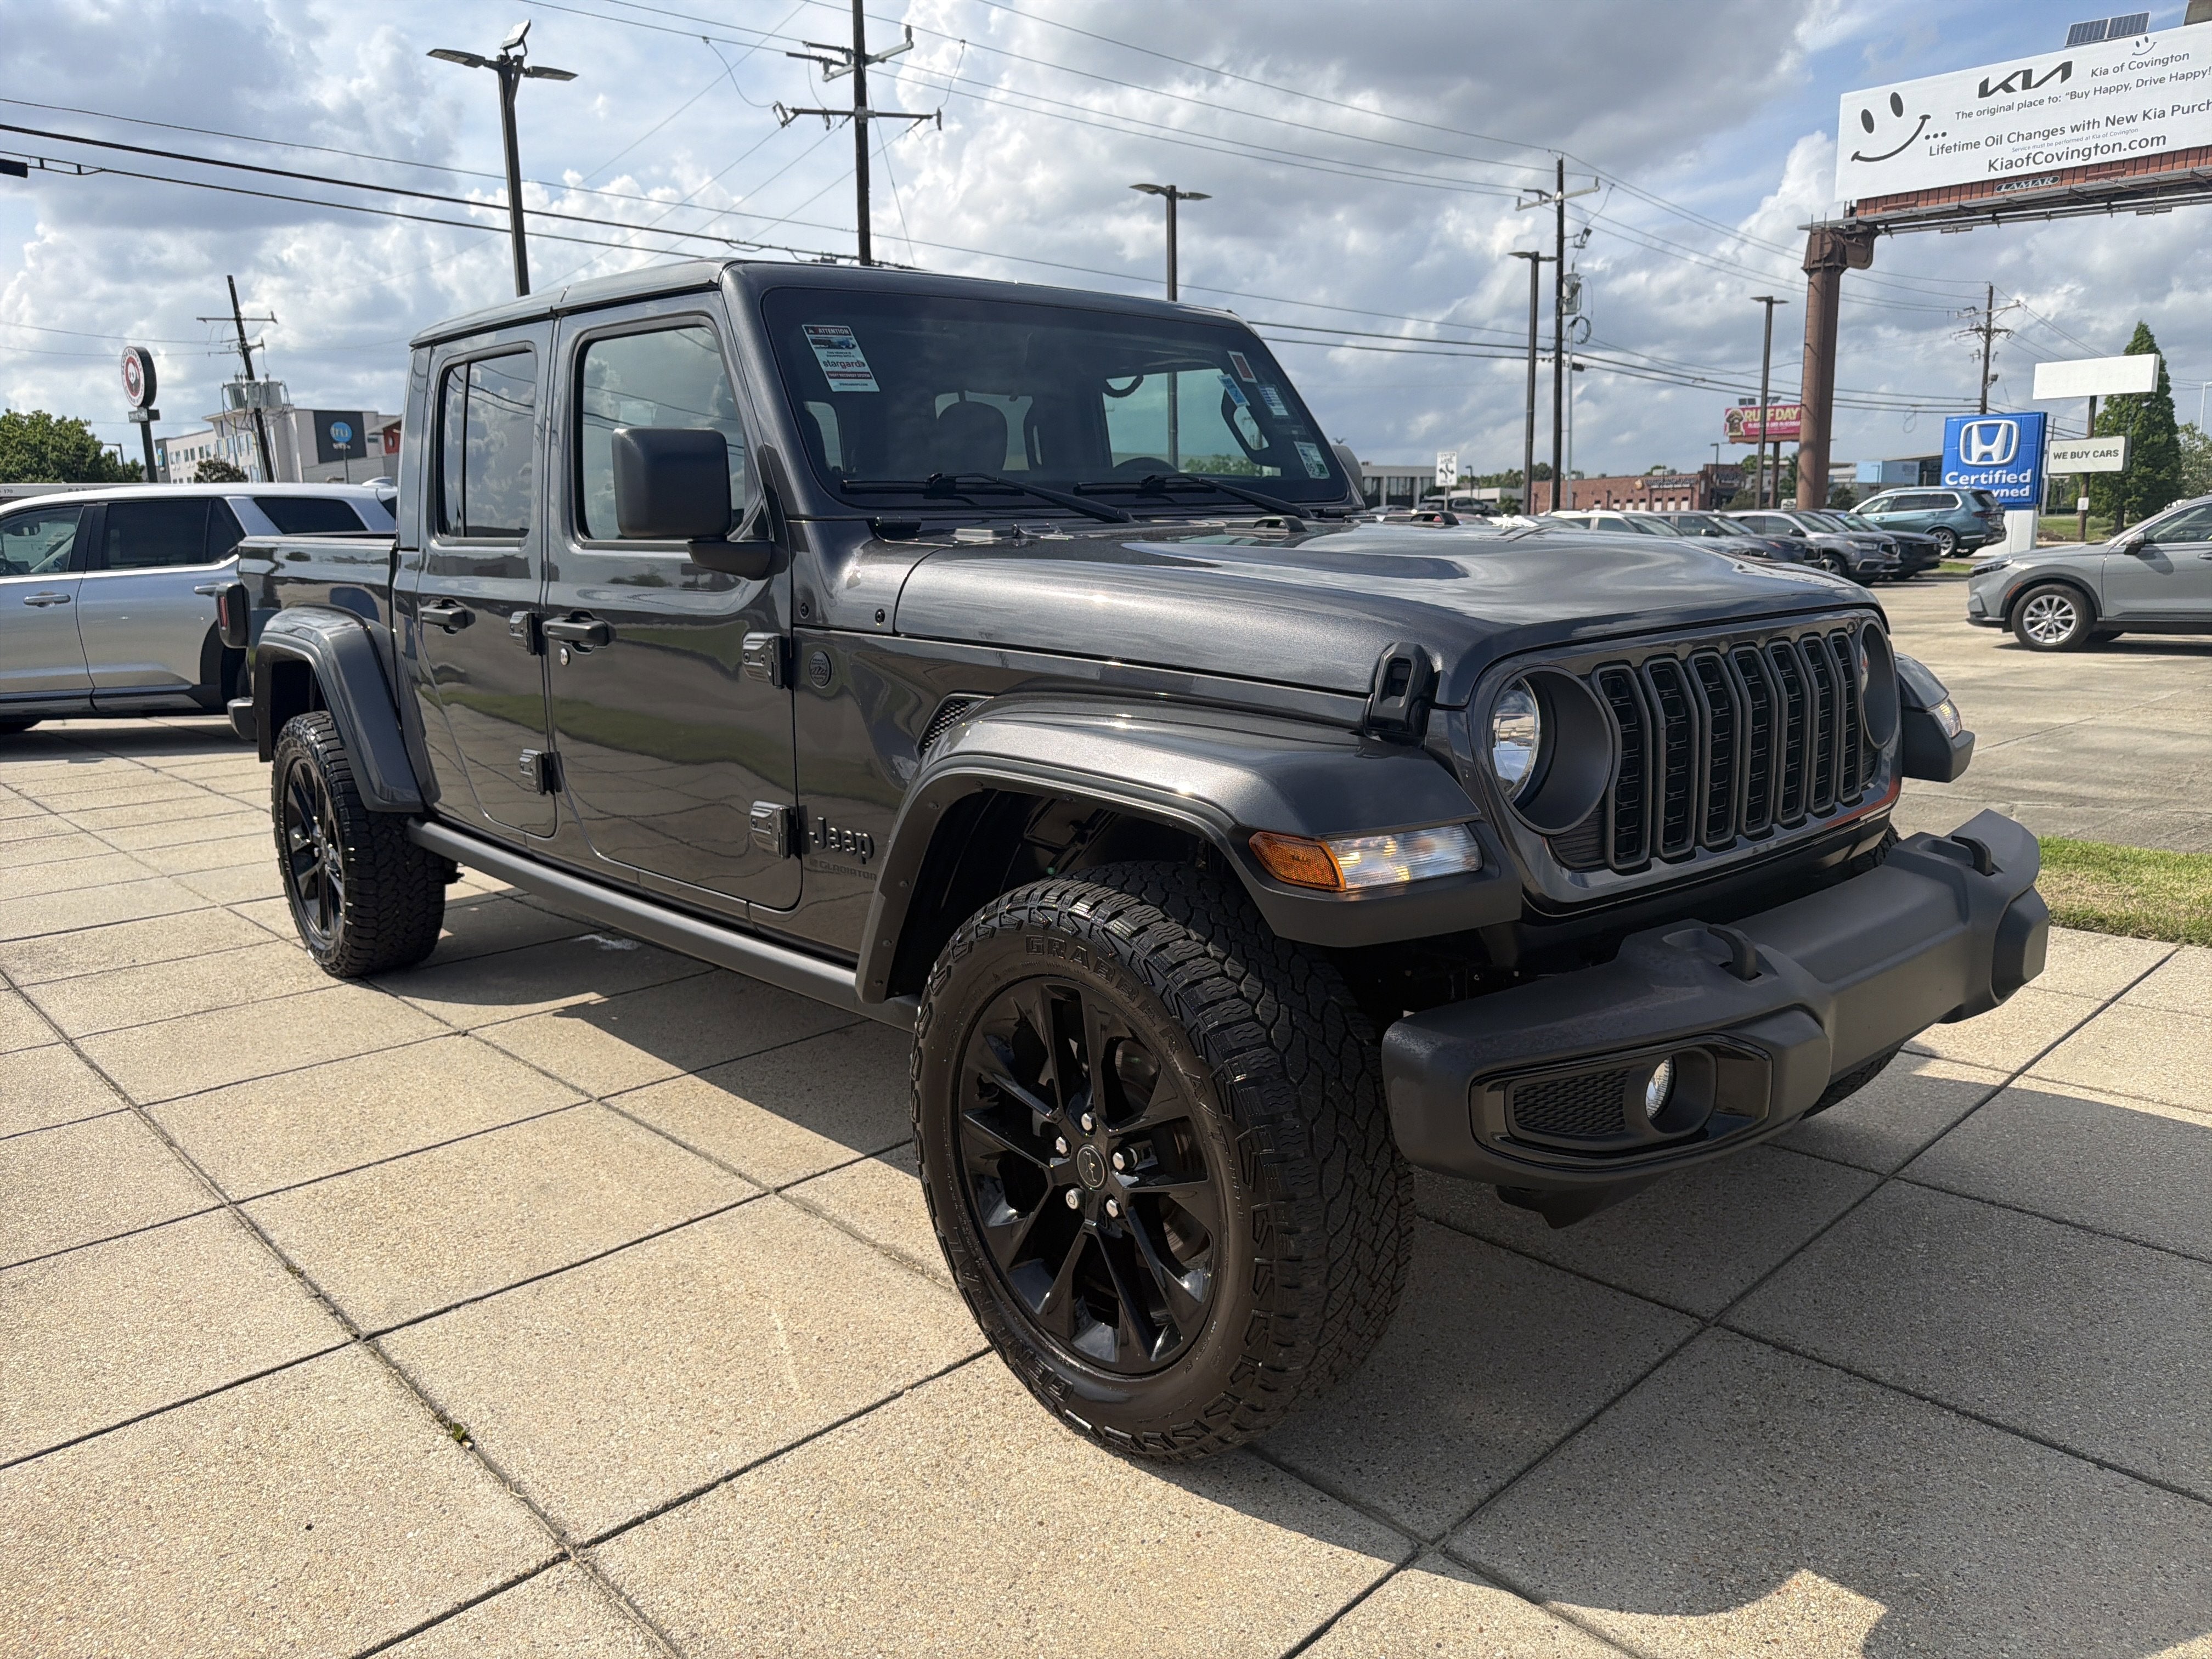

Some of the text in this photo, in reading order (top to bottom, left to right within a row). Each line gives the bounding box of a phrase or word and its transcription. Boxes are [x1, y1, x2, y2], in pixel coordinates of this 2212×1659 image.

[2091, 53, 2190, 77] Kia of Covington
[1955, 111, 1973, 120] The
[1976, 101, 2014, 117] original
[2017, 98, 2045, 111] place
[2047, 94, 2062, 104] to:
[2094, 82, 2132, 96] Happy,
[2136, 75, 2166, 88] Drive
[1929, 140, 1980, 156] Lifetime
[1985, 134, 2003, 147] Oil
[2007, 126, 2066, 141] Changes
[2070, 118, 2100, 133] with
[2105, 113, 2138, 128] New
[2142, 108, 2166, 121] Kia
[2011, 145, 2031, 153] Service
[2055, 137, 2084, 147] performed
[2109, 127, 2138, 137] Covington
[1988, 134, 2166, 172] KiaofCovington.com
[2001, 176, 2053, 191] LAMAR
[823, 360, 861, 369] stargard
[1744, 408, 1774, 422] RUF
[330, 425, 348, 437] tru
[2053, 449, 2119, 460] WE BUY CARS
[1945, 469, 2032, 486] Certified
[809, 816, 874, 865] Jeep
[819, 860, 877, 881] GLADIATOR
[1025, 934, 1185, 1060] GRABBER
